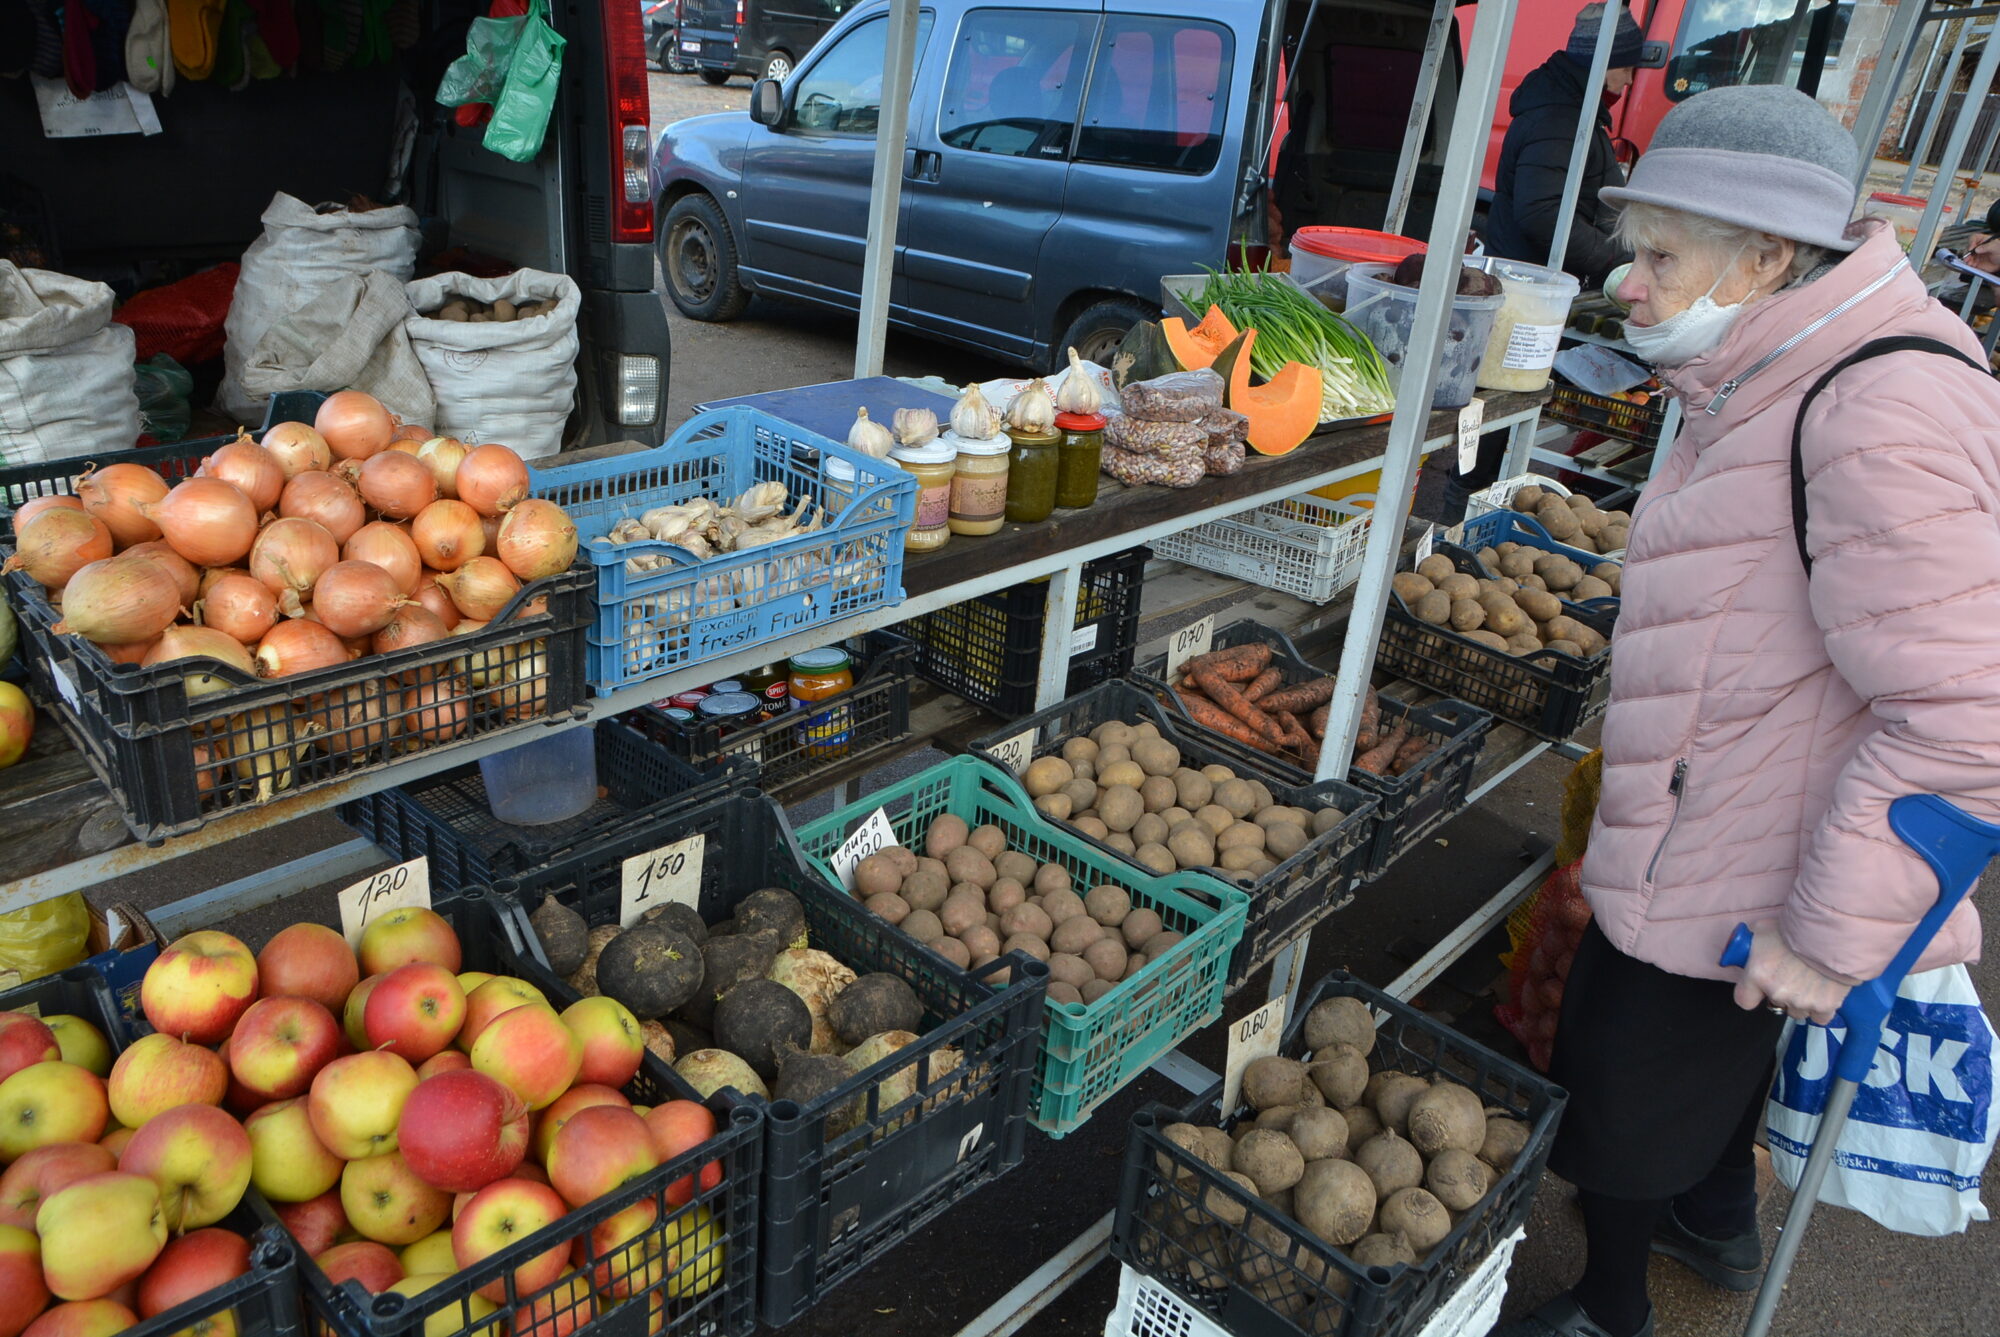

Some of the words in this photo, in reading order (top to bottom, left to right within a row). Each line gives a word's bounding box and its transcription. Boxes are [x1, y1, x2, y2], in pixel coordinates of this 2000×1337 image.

[699, 624, 757, 655] fresh
[770, 602, 820, 633] Fruit
[1240, 1008, 1269, 1043] 0.60
[1796, 1026, 1974, 1105] JSK
